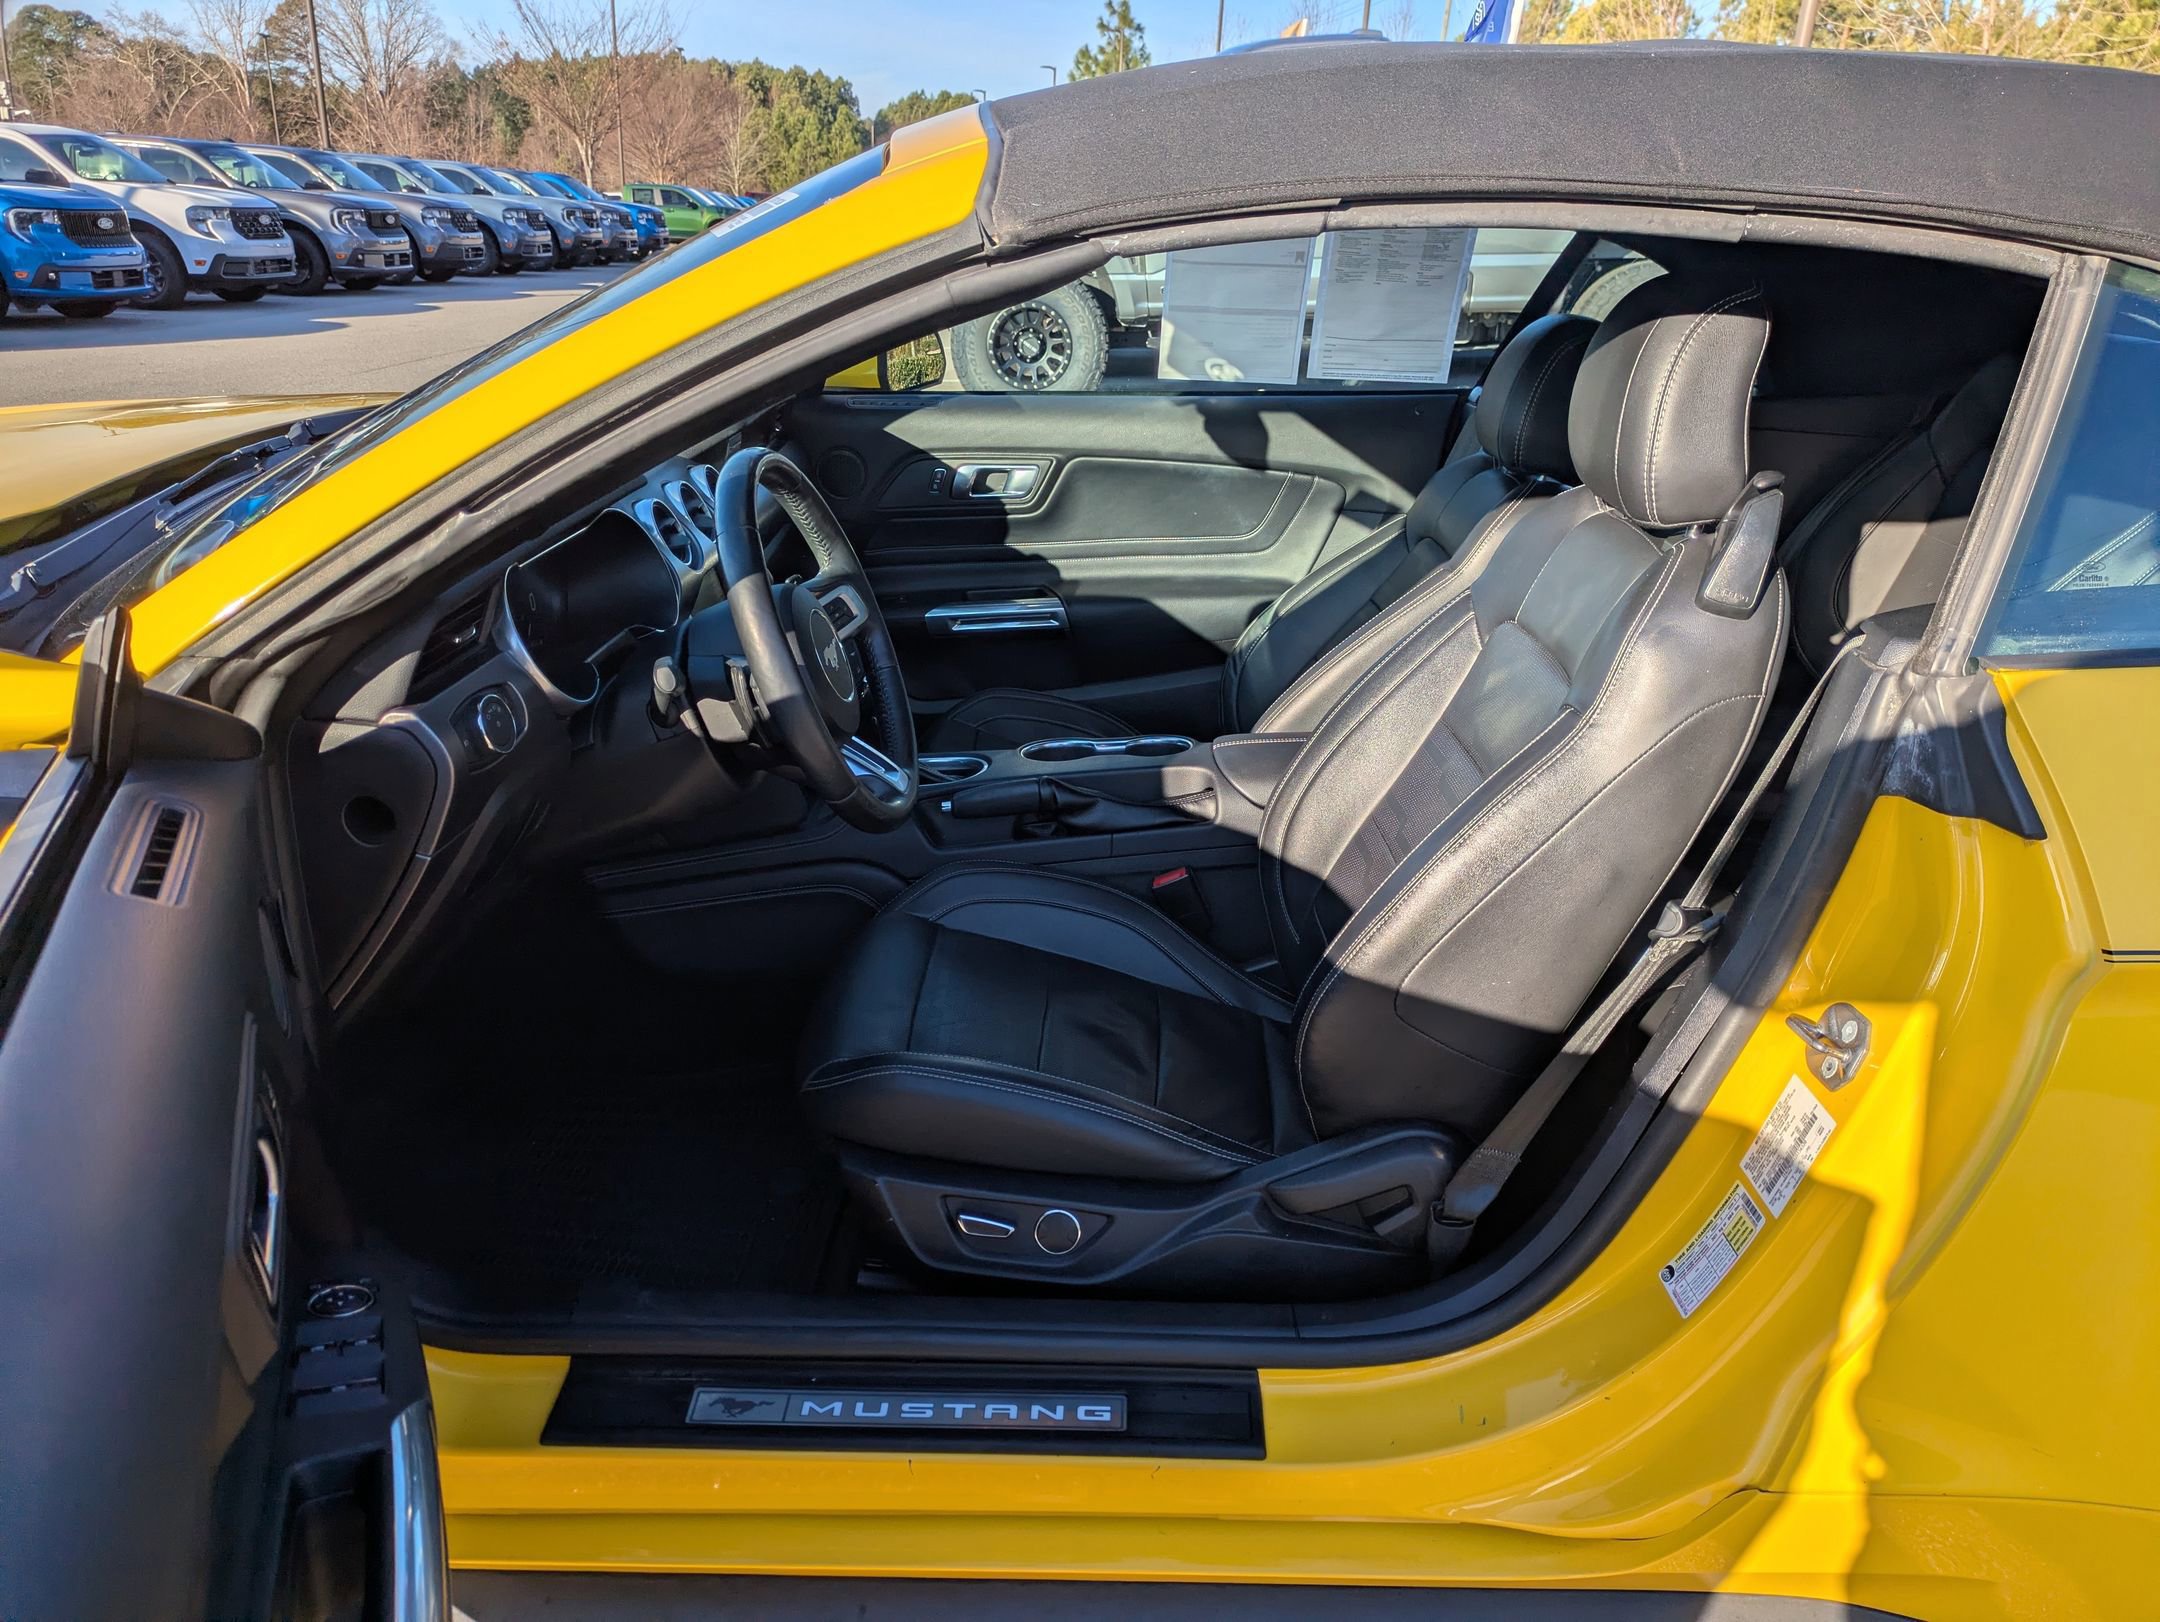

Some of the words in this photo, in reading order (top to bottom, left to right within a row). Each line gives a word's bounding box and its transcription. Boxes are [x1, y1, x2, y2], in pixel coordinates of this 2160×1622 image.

[1674, 1251, 1685, 1264] TIRE
[1686, 1241, 1696, 1253] AND
[1694, 1218, 1713, 1242] LOADING
[1713, 1183, 1739, 1220] INFORMATION
[800, 1400, 1112, 1422] MUSTANG
